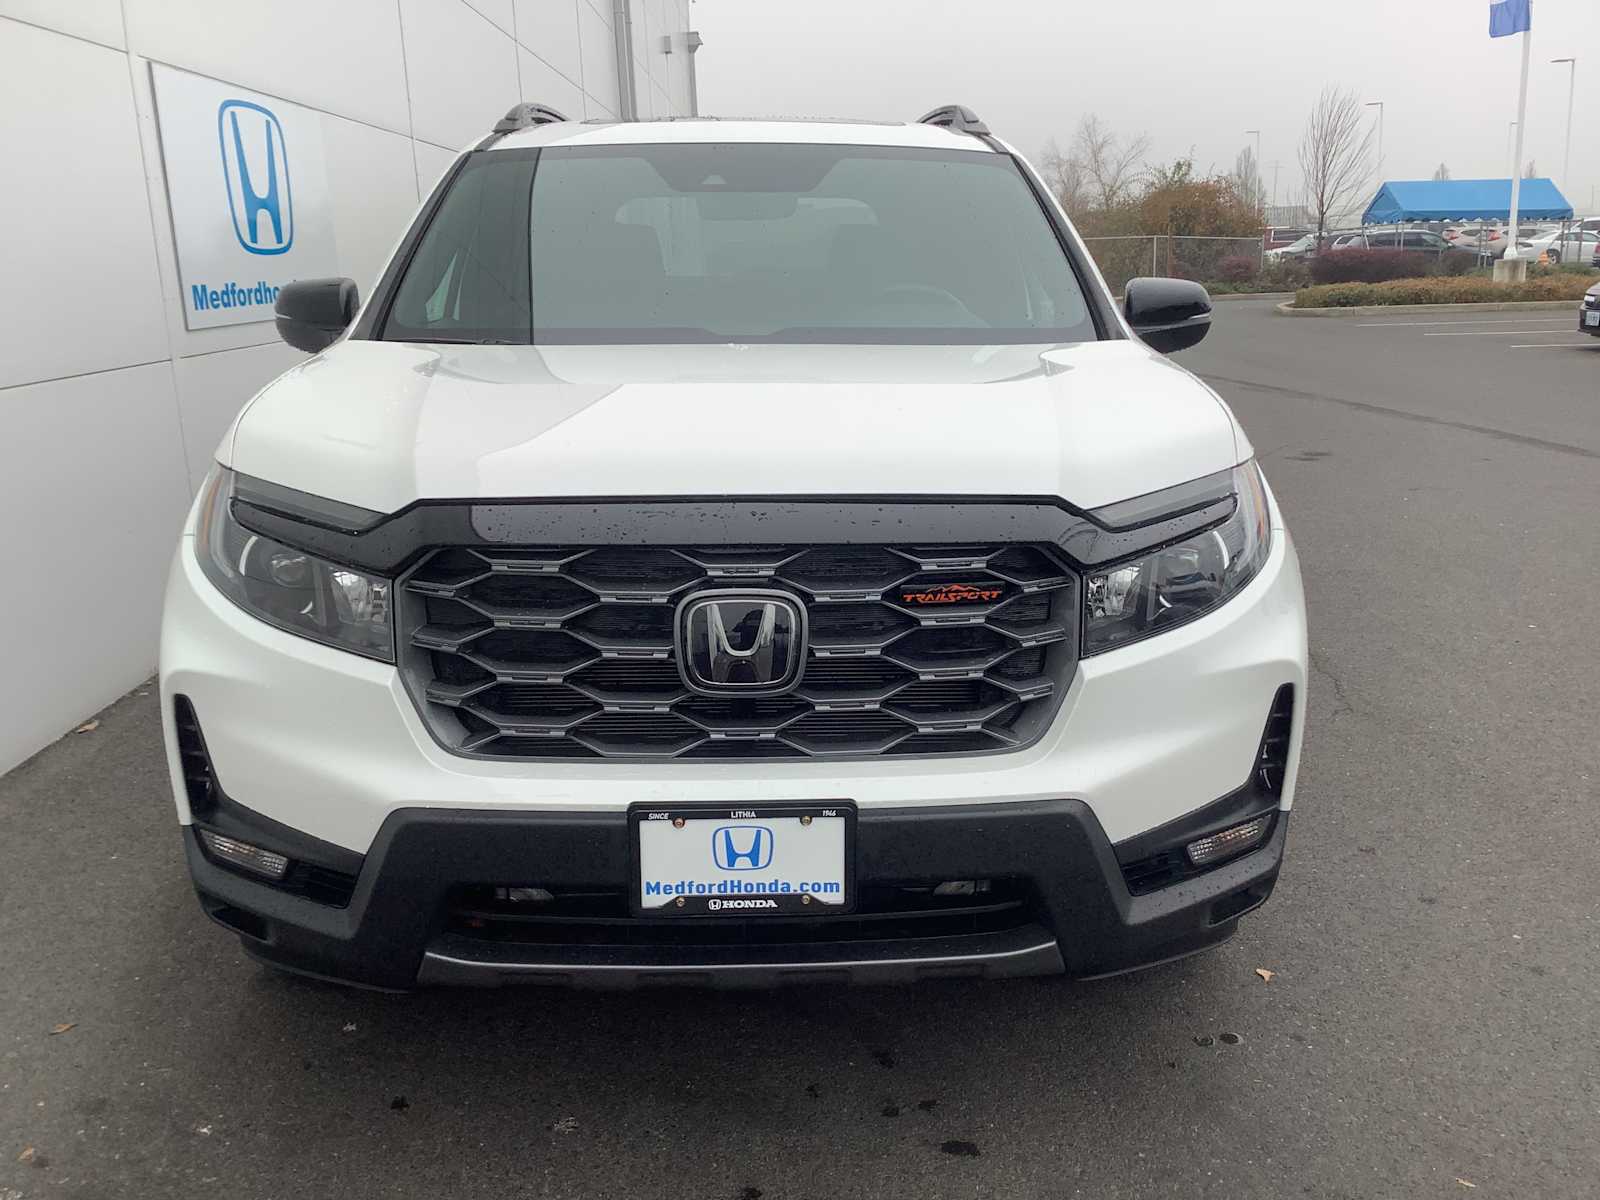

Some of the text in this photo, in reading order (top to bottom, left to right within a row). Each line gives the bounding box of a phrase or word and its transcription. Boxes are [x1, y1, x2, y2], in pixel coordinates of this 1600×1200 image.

[903, 591, 1003, 604] TRAILSPORT
[647, 812, 670, 820] SINCE
[731, 810, 757, 819] LITHIA
[645, 880, 840, 896] MedfordHonda.com
[722, 899, 778, 909] HONDA
